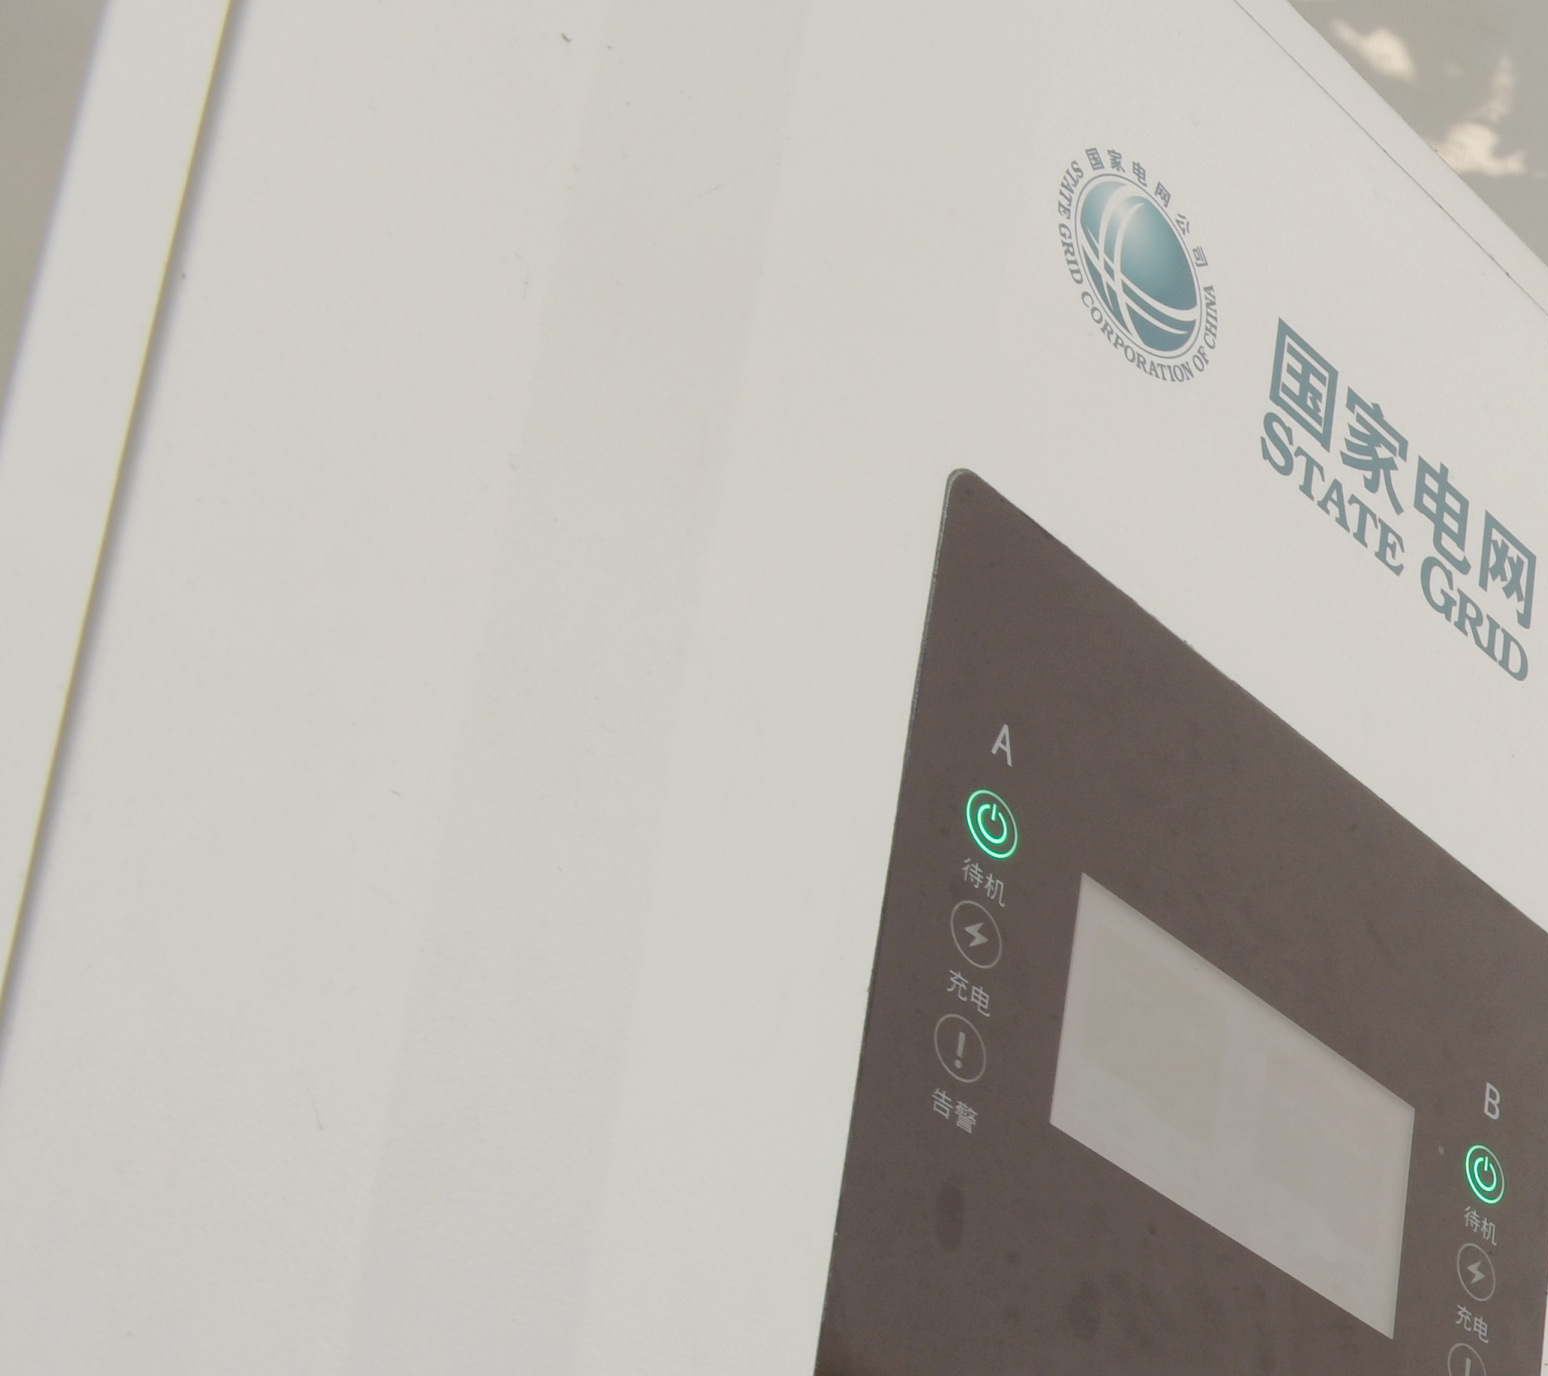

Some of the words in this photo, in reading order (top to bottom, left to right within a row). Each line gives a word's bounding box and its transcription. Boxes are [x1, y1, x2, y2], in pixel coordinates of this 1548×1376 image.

[1058, 161, 1084, 220] STATE
[1085, 148, 1208, 267] 国家电网公司
[1059, 223, 1083, 285] GRID
[1081, 291, 1194, 383] CORPORATION
[1203, 285, 1218, 350] CHINA
[1192, 346, 1209, 372] OF
[1269, 318, 1536, 630] 国家电网
[1260, 411, 1404, 576] STATE
[1420, 556, 1528, 681] GRID
[991, 724, 1013, 767] A
[962, 857, 1005, 907] 待机
[947, 969, 990, 1017] 充电
[931, 1088, 978, 1135] 告警
[1484, 1082, 1500, 1120] B
[1464, 1206, 1497, 1246] 待机
[1455, 1304, 1489, 1343] 充电
